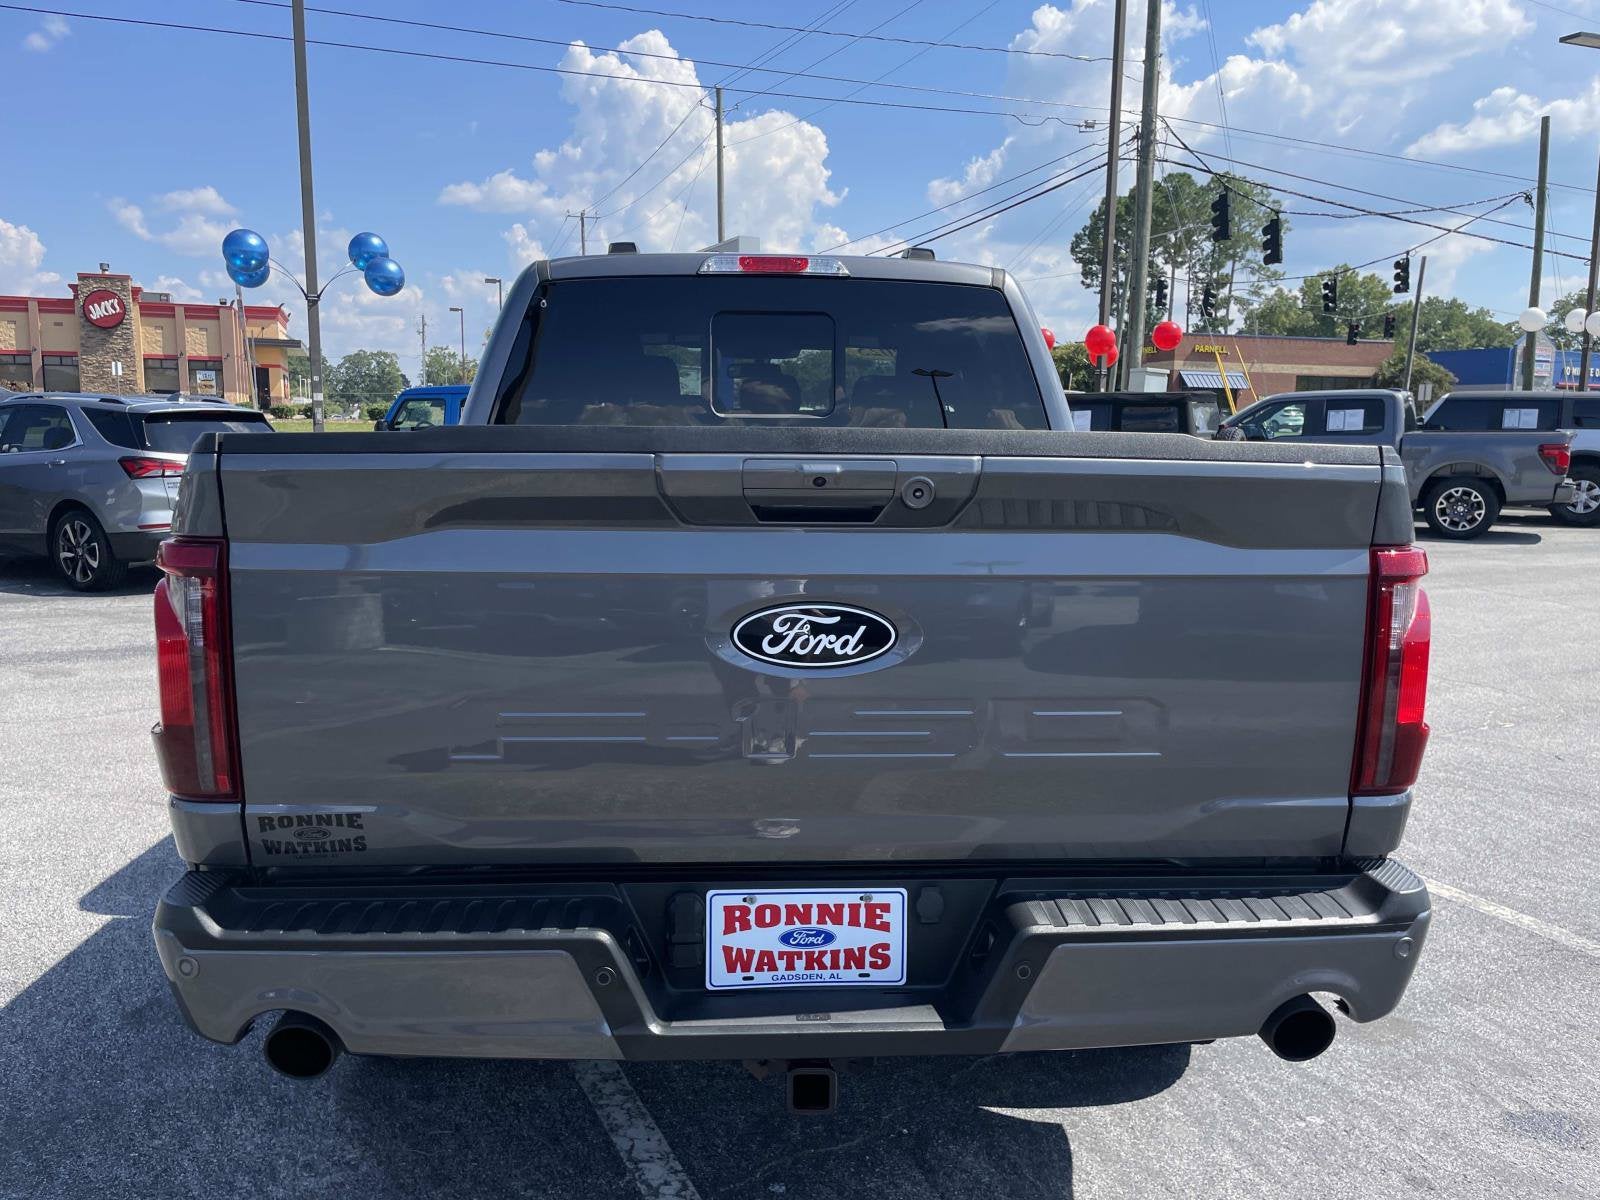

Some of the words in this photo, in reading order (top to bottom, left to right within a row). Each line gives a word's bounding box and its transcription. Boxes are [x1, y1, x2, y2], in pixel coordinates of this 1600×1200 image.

[1194, 345, 1228, 354] PARNELL
[761, 613, 866, 656] Ford
[258, 813, 364, 833] RONNIE
[261, 836, 367, 855] WATKINS
[723, 903, 891, 936] RONNIE
[789, 930, 825, 946] Ford
[721, 942, 891, 974] WATKINS
[771, 974, 826, 982] GADSDEN,
